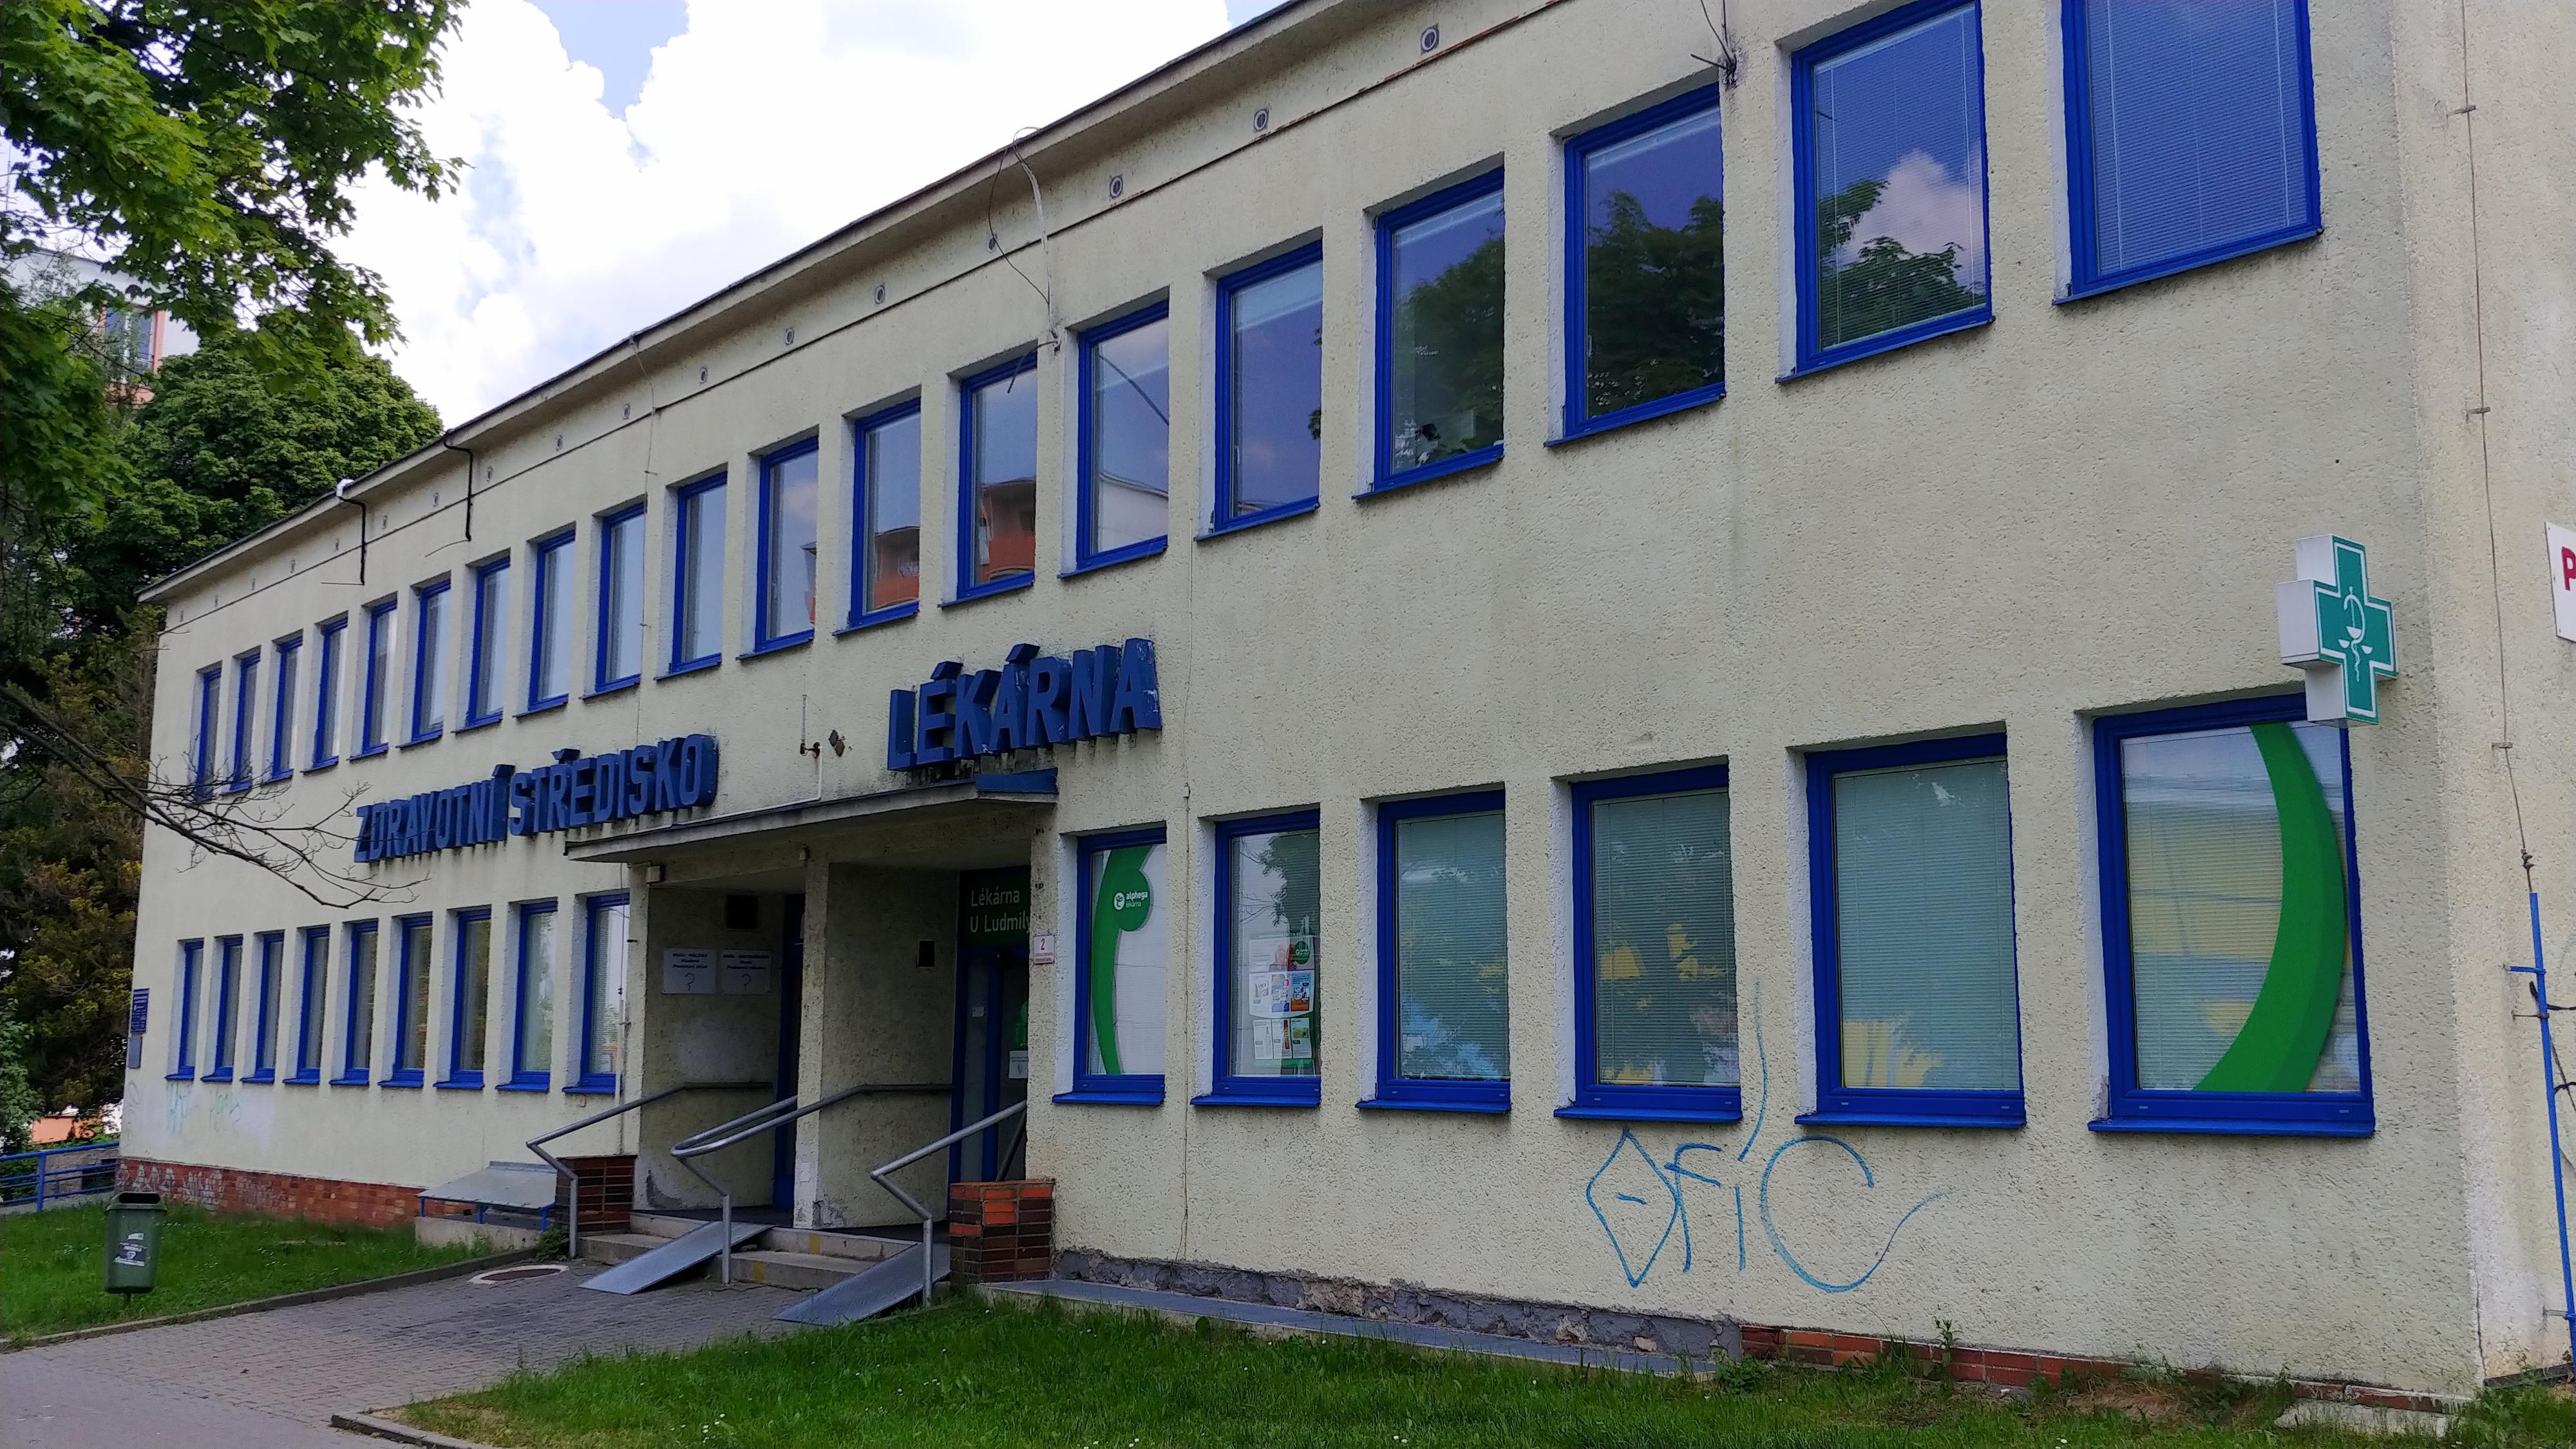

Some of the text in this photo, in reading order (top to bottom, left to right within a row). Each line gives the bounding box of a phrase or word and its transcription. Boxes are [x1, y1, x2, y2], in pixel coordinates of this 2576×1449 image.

[887, 637, 1162, 771] LÉKÁRNA
[354, 734, 719, 862] ZDRAVOTNÍ STŘEDISKO
[971, 886, 1021, 907] Lékárna
[1126, 891, 1148, 901] alphega
[969, 914, 979, 933] U
[1041, 938, 1045, 951] 2
